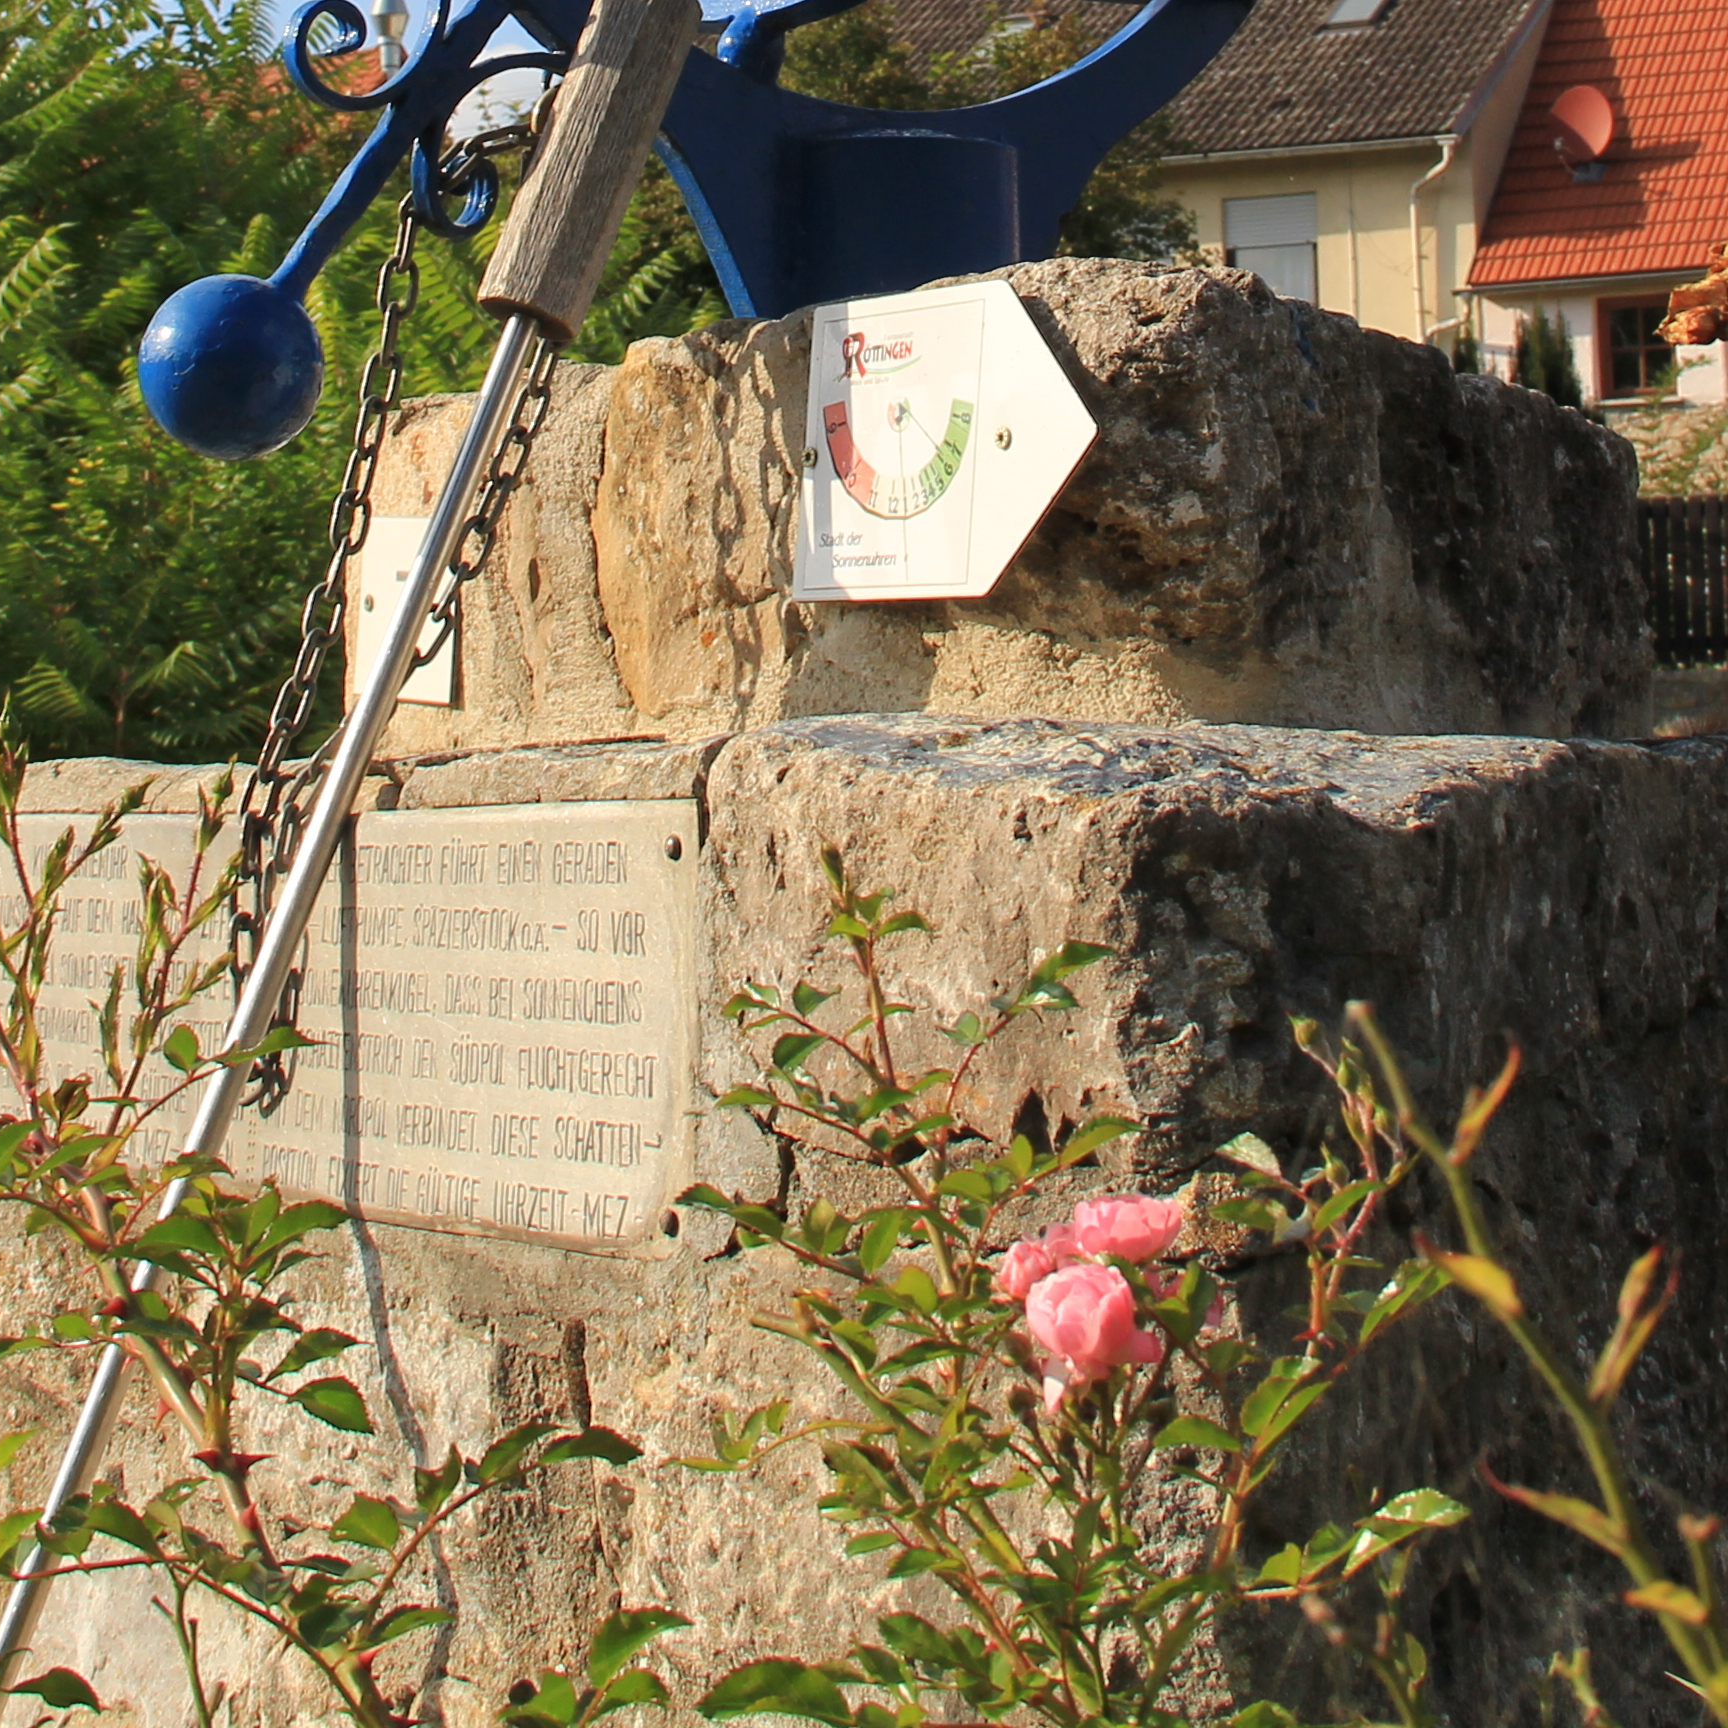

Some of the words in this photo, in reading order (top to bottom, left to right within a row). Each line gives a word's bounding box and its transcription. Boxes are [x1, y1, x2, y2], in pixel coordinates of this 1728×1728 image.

[944, 463, 953, 477] 6
[927, 482, 936, 498] 4
[935, 477, 944, 491] 5
[888, 497, 899, 513] 12
[912, 492, 920, 510] 2
[921, 489, 929, 505] 3
[819, 532, 844, 548] Stadt
[846, 531, 863, 546] der
[832, 551, 896, 568] Sonnenuhren
[440, 838, 488, 885] FÜHRT
[497, 840, 543, 885] EINEN
[552, 841, 628, 885] GERADEN
[87, 897, 114, 934] DEM
[576, 909, 600, 953] SO
[610, 910, 647, 957] VOR
[444, 973, 481, 1015] DASS
[488, 977, 514, 1021] BEI
[450, 1033, 506, 1085] SÜDPOL
[517, 1046, 657, 1098] FLUCHTGERECHT
[295, 1088, 324, 1132] DEM
[491, 1113, 541, 1159] DIESE
[262, 1144, 318, 1190] POSITION
[386, 1168, 411, 1210] DIE
[416, 1165, 481, 1222] GÜLTIGE
[492, 1179, 570, 1232] UHRZEIT
